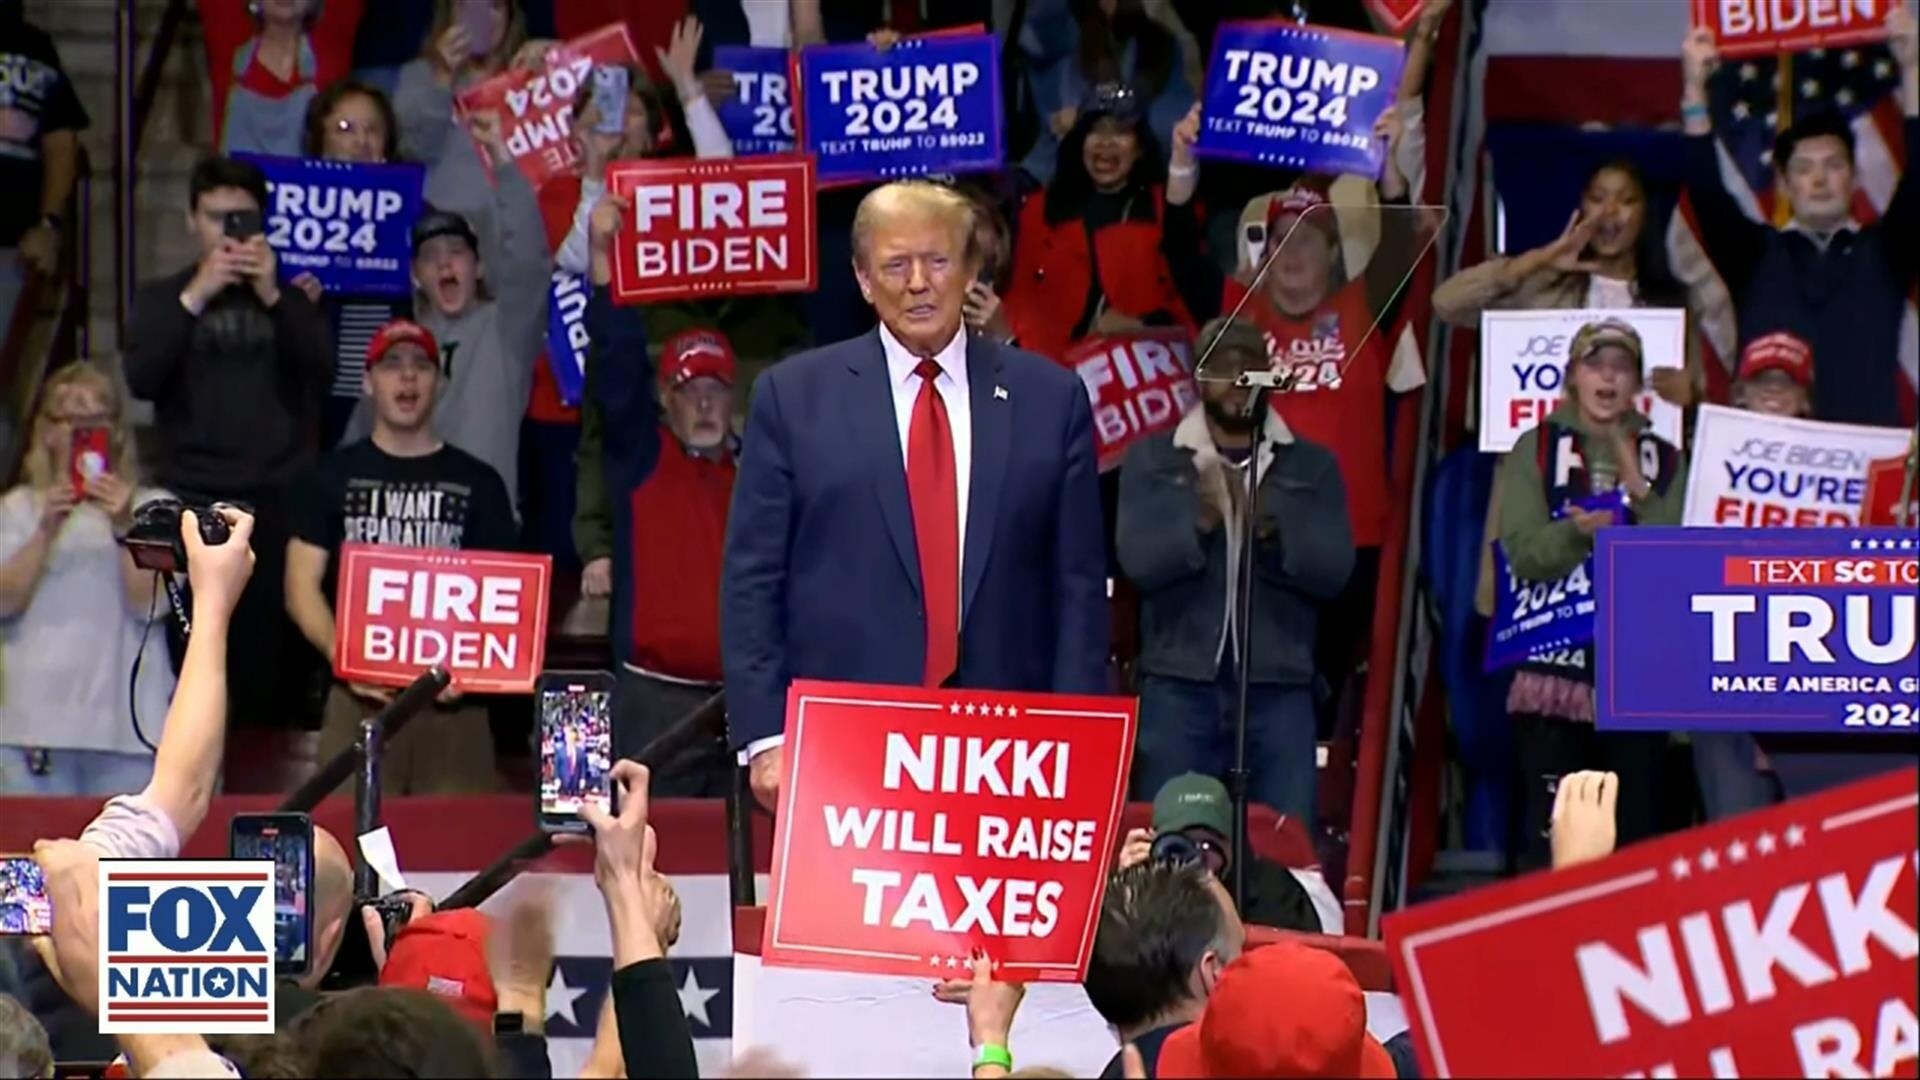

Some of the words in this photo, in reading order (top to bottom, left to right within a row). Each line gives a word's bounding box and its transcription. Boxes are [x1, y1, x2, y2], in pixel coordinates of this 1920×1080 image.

[1718, 0, 1875, 36] BIDEN
[820, 61, 979, 104] TRUMP
[1225, 50, 1379, 97] TRUMP
[844, 96, 959, 136] 2024
[1234, 83, 1348, 127] 2024
[820, 139, 856, 155] TEXT
[861, 135, 913, 152] TRUMP
[916, 135, 937, 149] TO
[1207, 117, 1243, 132] TEXT
[1246, 122, 1297, 139] TRUMP
[1300, 127, 1320, 143] TO
[265, 180, 403, 222] RUMP
[634, 179, 788, 232] FIRE
[266, 215, 377, 254] 2024
[636, 235, 788, 278] BIDEN
[1517, 334, 1566, 357] JOE
[1094, 381, 1200, 446] BIDE
[1733, 437, 1785, 462] JOE
[1786, 444, 1866, 471] BIDEN
[1724, 460, 1867, 504] YOU'RE
[371, 490, 379, 517] I
[384, 491, 444, 520] WANT
[1748, 560, 1826, 583] TEXT
[1834, 560, 1876, 584] SC
[366, 567, 522, 624] FIRE
[363, 625, 517, 669] BIDEN
[1691, 594, 1917, 665] TRU
[1711, 676, 1778, 692] MAKE
[1784, 676, 1892, 692] AMERICA
[1899, 677, 1919, 692] G
[883, 732, 1070, 799] NIKKI
[823, 805, 962, 855] WILL
[976, 815, 1097, 862] RAISE
[851, 867, 1064, 938] TAXES
[1575, 855, 1919, 1044] NIKK
